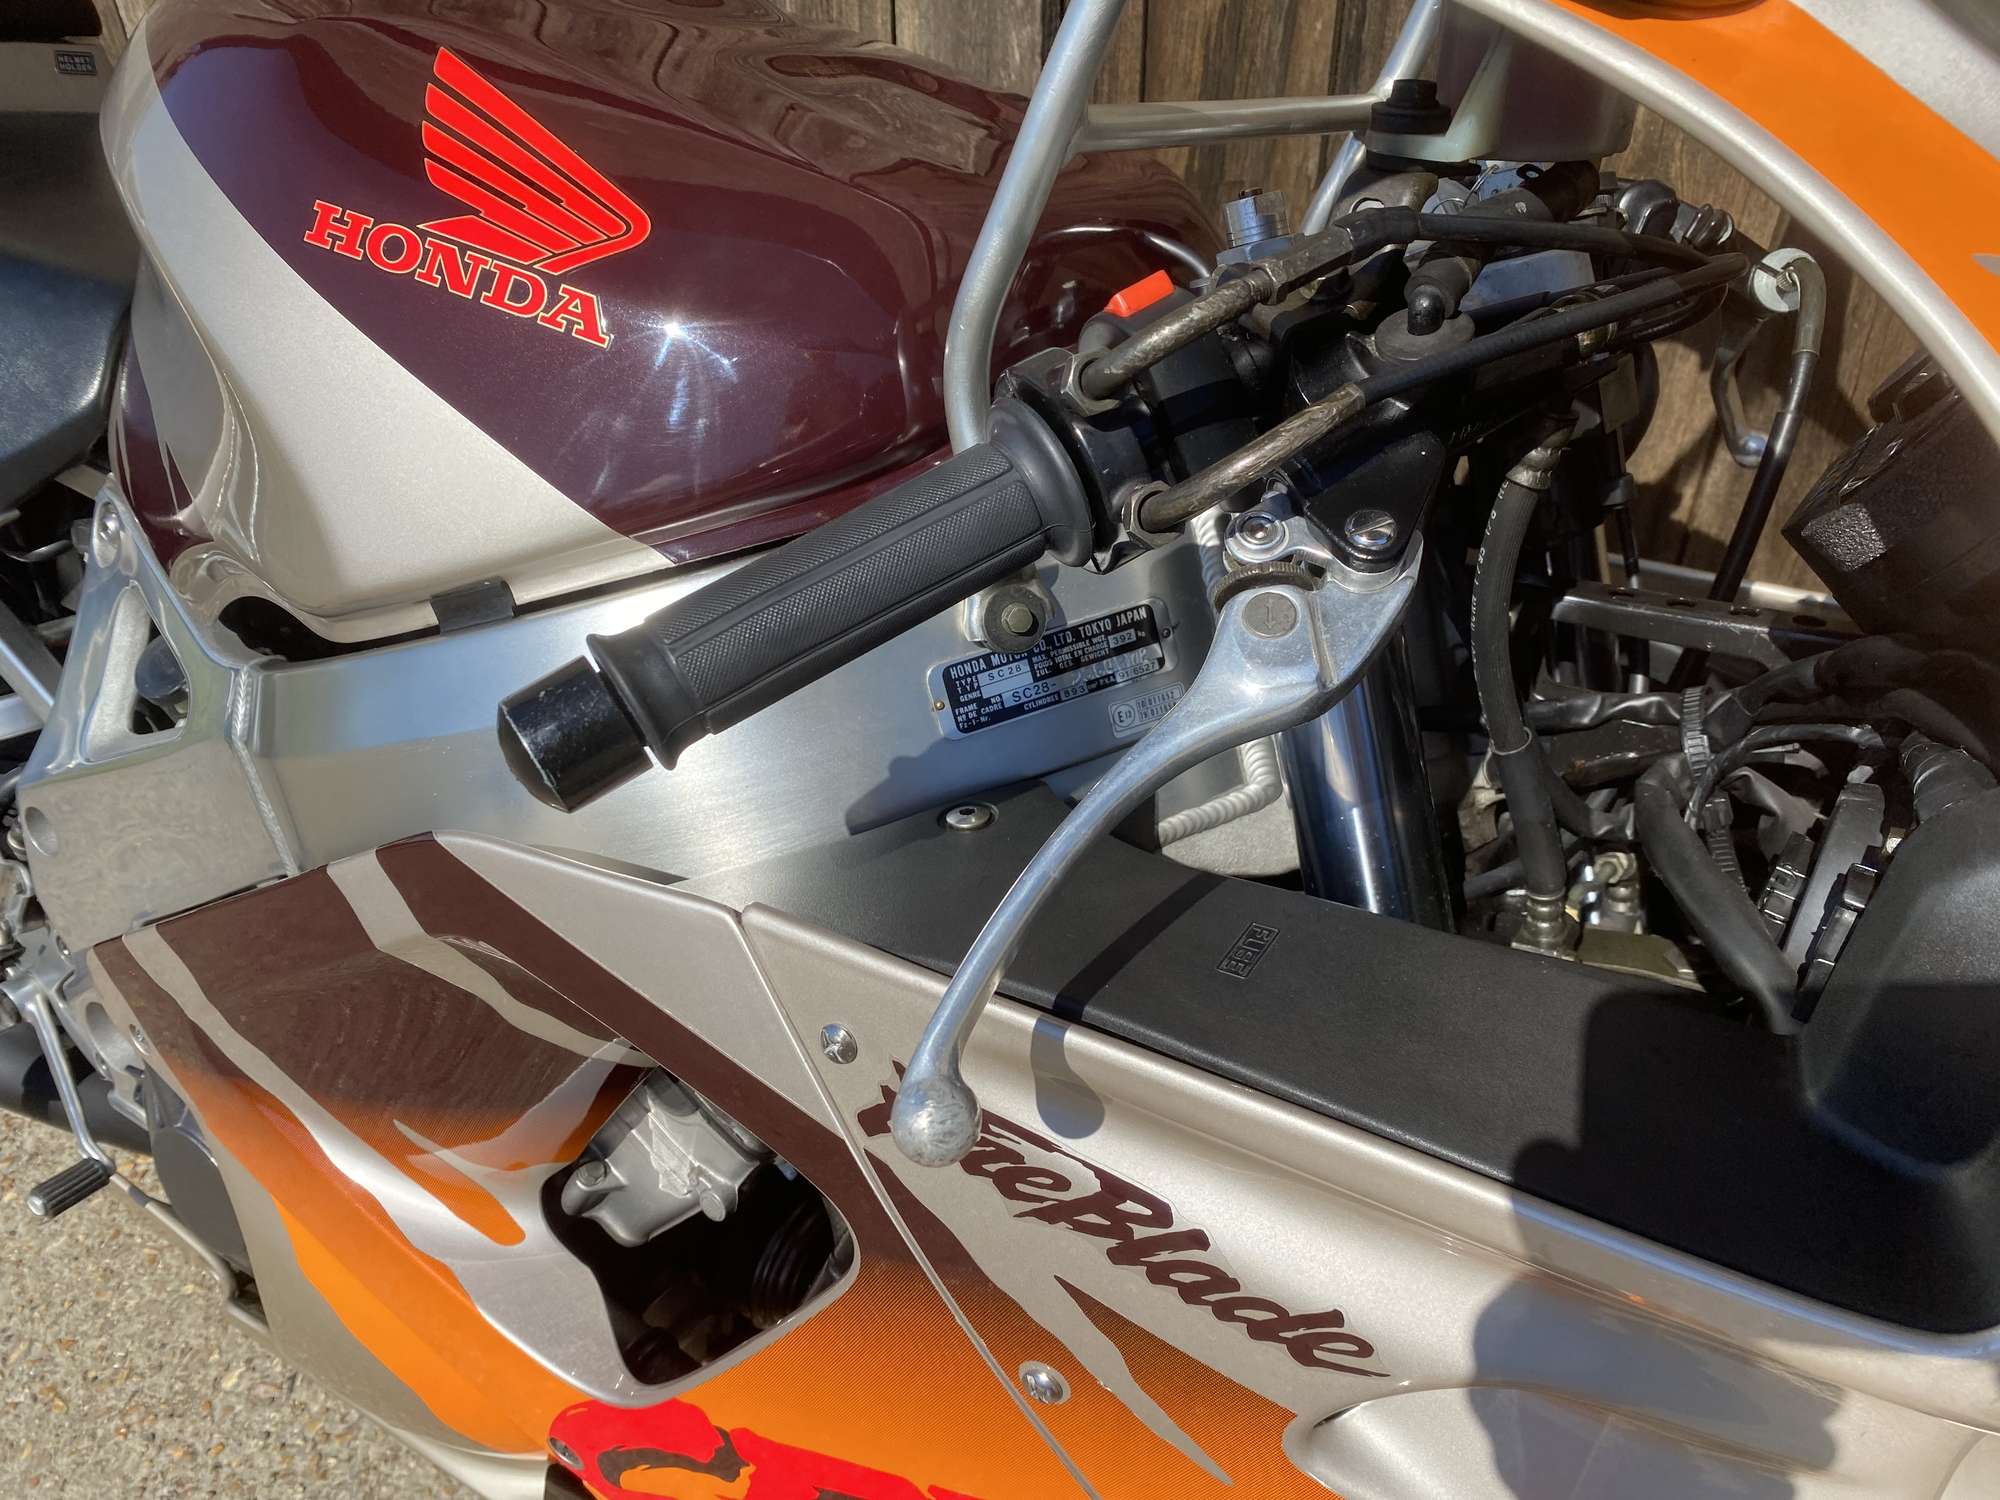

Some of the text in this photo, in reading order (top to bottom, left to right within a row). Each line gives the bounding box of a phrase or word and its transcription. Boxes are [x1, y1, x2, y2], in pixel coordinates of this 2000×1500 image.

[304, 200, 612, 349] HONDA
[949, 658, 987, 680] HONDA
[1053, 631, 1076, 647] LTD.
[1114, 607, 1148, 627] JAPAN
[1113, 633, 1133, 645] 392
[1054, 653, 1072, 664] TOTAL
[1073, 649, 1083, 657] EN
[1084, 641, 1109, 654] CHARGE
[1080, 648, 1110, 663] GEWICHT
[955, 675, 977, 688] TYPE
[957, 683, 979, 695] TYP
[1064, 685, 1086, 697] 893
[959, 690, 981, 703] GENRE
[955, 703, 978, 716] FRAME
[968, 711, 978, 719] DE
[980, 702, 1003, 715] CADRE
[1223, 926, 1271, 974] FUSE
